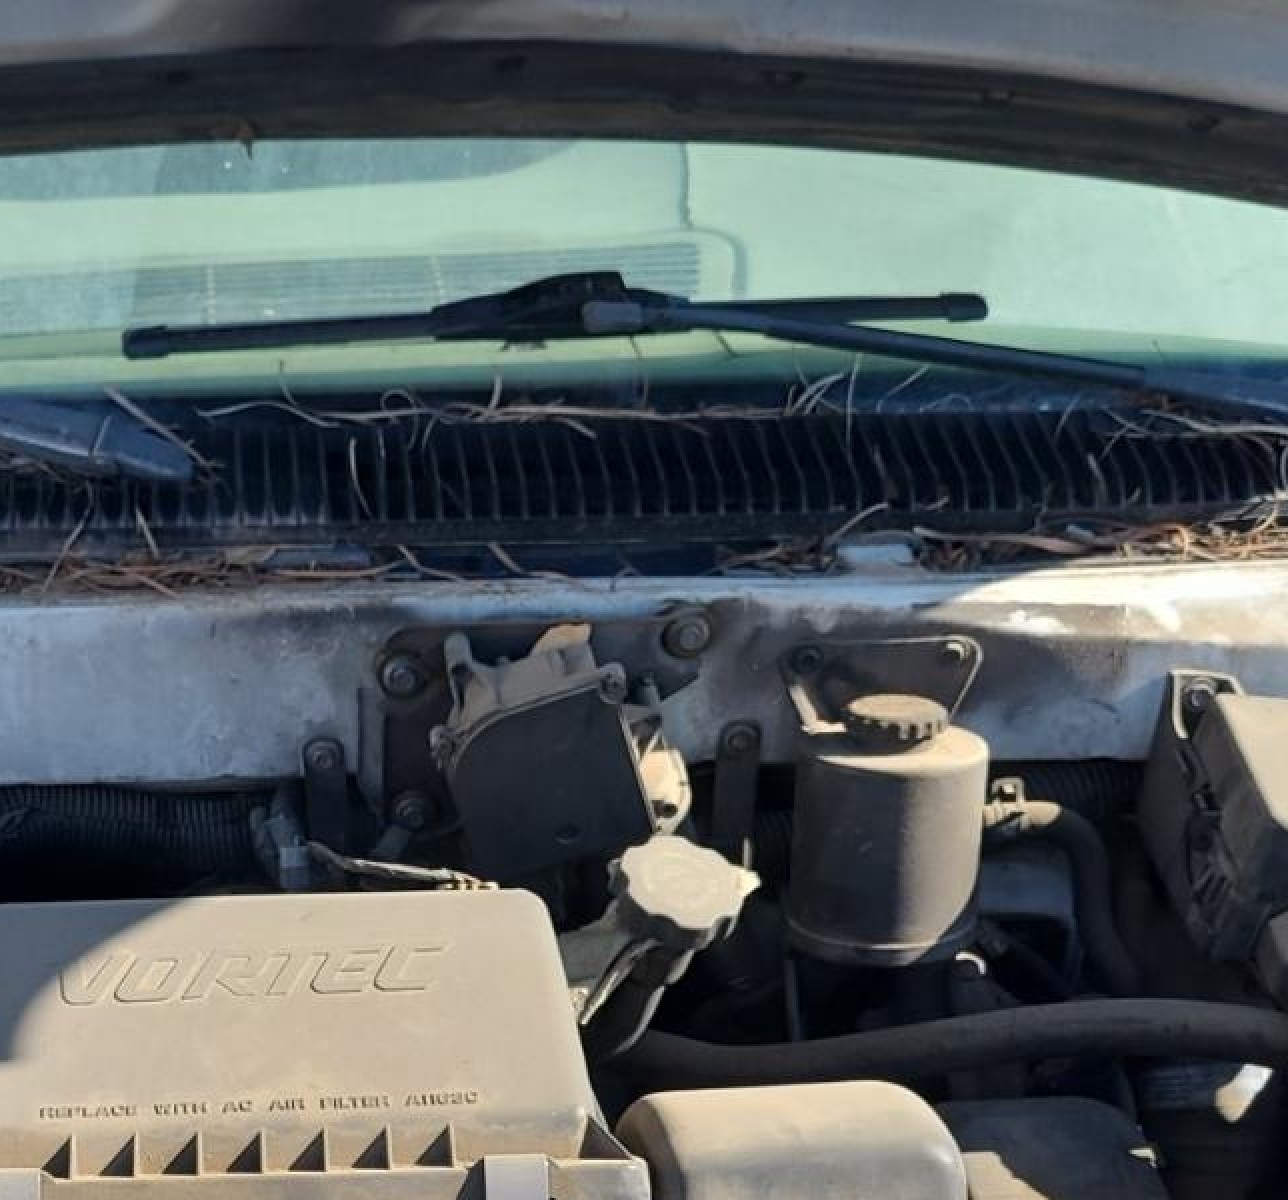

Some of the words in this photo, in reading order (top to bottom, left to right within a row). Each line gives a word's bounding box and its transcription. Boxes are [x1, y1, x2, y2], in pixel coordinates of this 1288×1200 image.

[58, 944, 450, 1006] VORTEC
[39, 1105, 137, 1119] REPLACE
[153, 1102, 208, 1116] WITH
[222, 1100, 253, 1115] AC
[269, 1098, 306, 1112] AIR
[319, 1095, 391, 1110] FILTER
